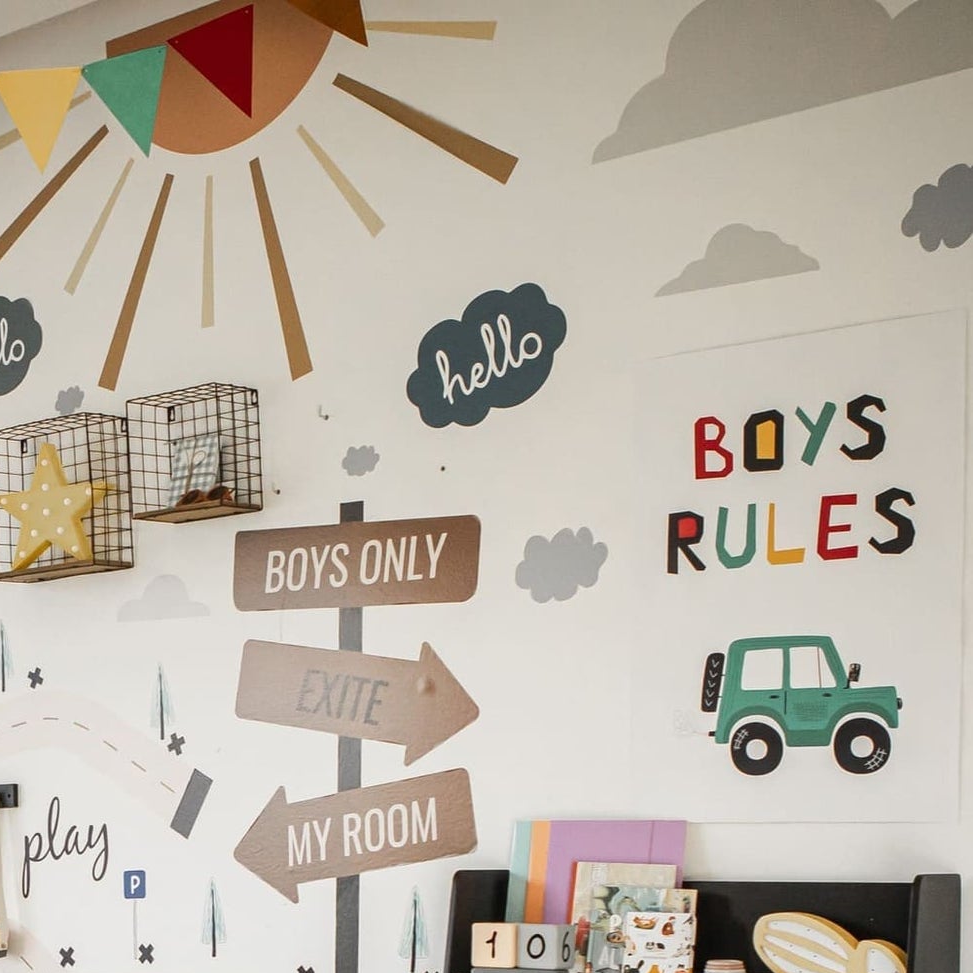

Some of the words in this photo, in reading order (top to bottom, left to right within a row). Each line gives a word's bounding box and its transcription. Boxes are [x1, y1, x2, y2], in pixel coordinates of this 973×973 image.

[435, 313, 543, 405] hello
[694, 394, 887, 480] BOYS
[265, 543, 349, 594] BOYS
[359, 532, 448, 585] ONLY
[667, 487, 916, 574] RULES
[295, 668, 389, 726] EXITE
[21, 796, 109, 898] play
[287, 817, 331, 867] MY
[342, 797, 438, 858] ROOM
[131, 875, 141, 895] P
